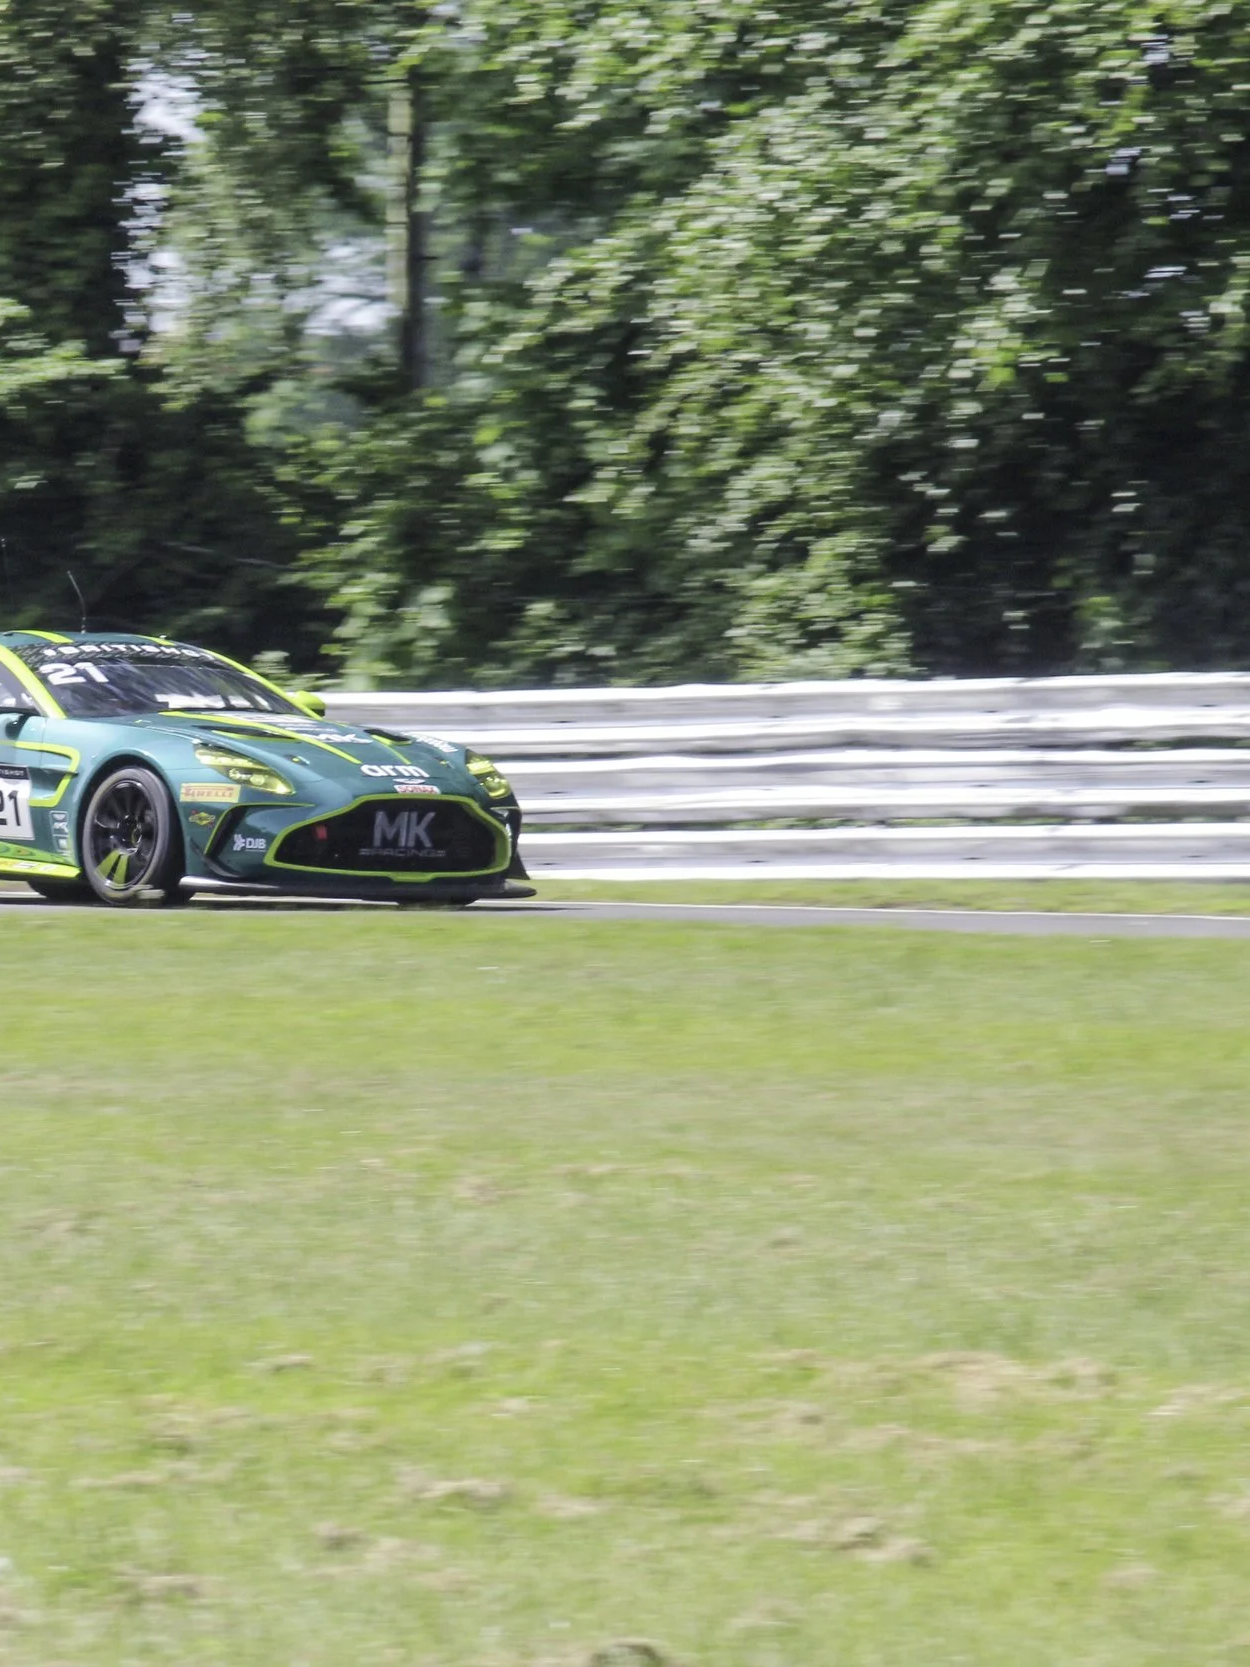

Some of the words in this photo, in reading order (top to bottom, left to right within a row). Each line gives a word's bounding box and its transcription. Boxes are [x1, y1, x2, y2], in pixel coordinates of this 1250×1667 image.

[39, 662, 109, 685] 21
[360, 764, 430, 778] arm
[183, 785, 234, 797] PIRELLI
[373, 811, 436, 848] MK
[246, 837, 266, 849] DJB
[371, 848, 436, 857] RACING
